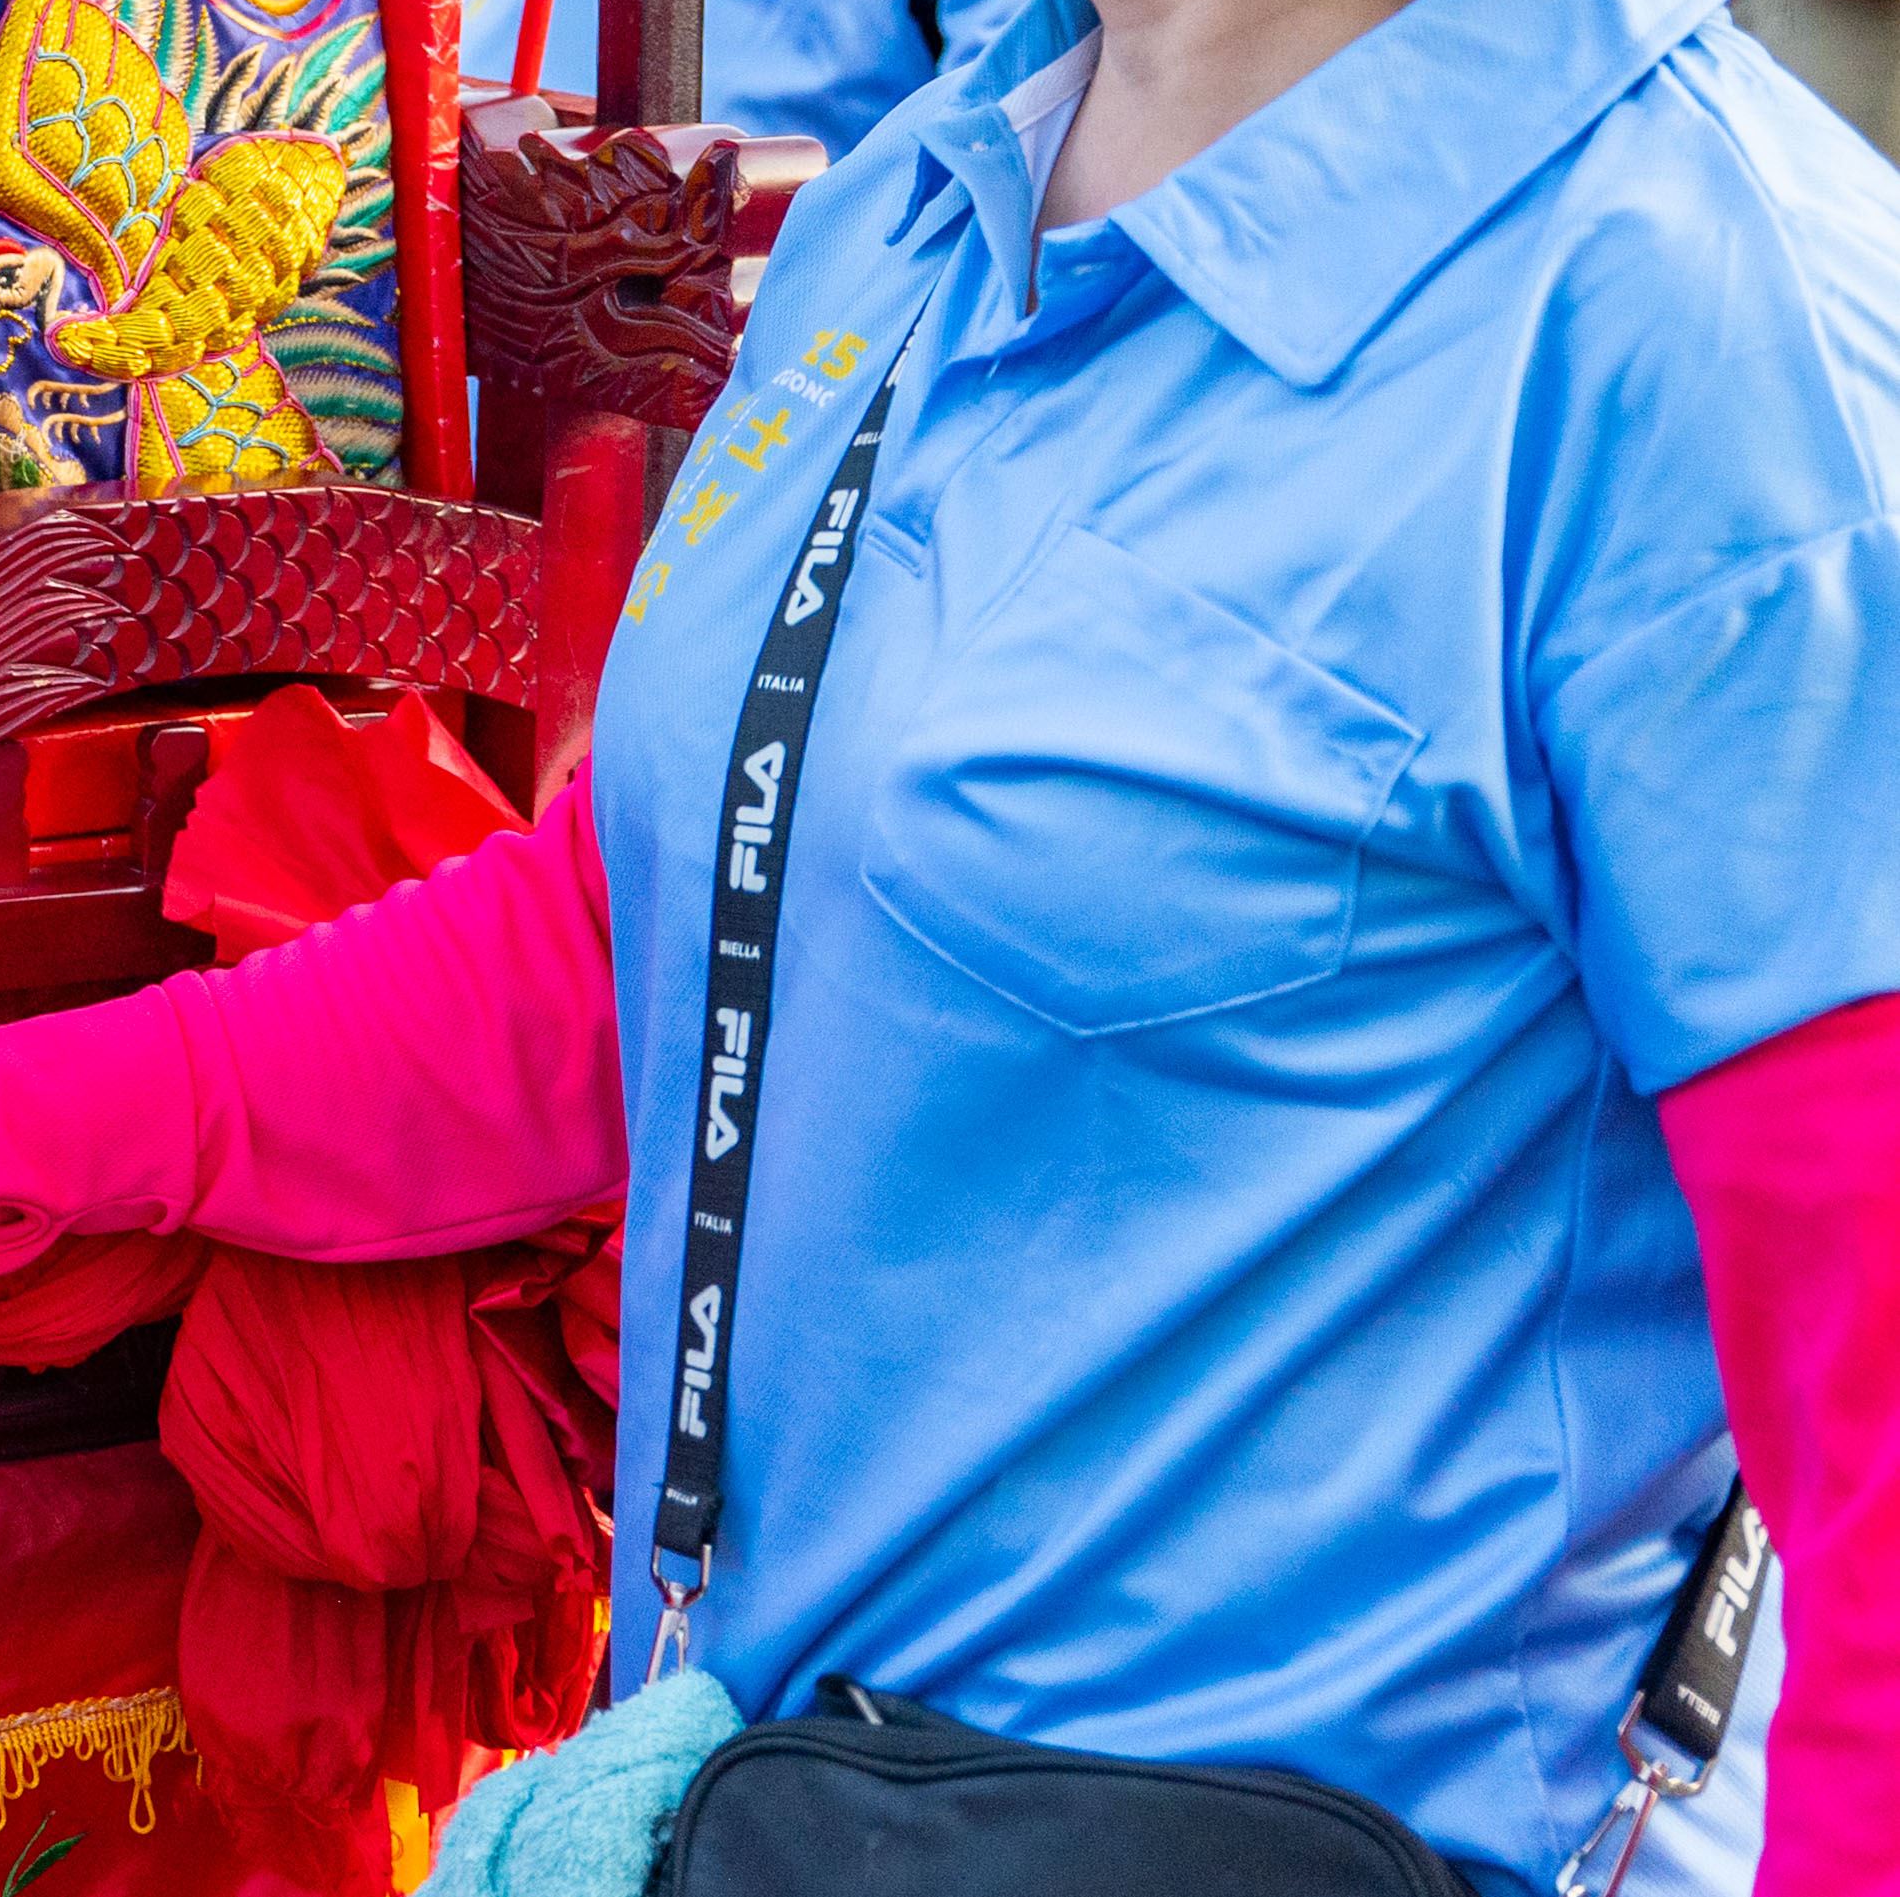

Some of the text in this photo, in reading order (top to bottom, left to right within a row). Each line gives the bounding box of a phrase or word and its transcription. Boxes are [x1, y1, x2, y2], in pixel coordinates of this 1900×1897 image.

[783, 487, 860, 627] FILA
[756, 674, 805, 694] ITALIA
[729, 740, 787, 895] FILA
[718, 939, 761, 961] BIELLA
[705, 1007, 752, 1162] FILA
[694, 1211, 733, 1235] ITALIA
[679, 1283, 722, 1440] FILA
